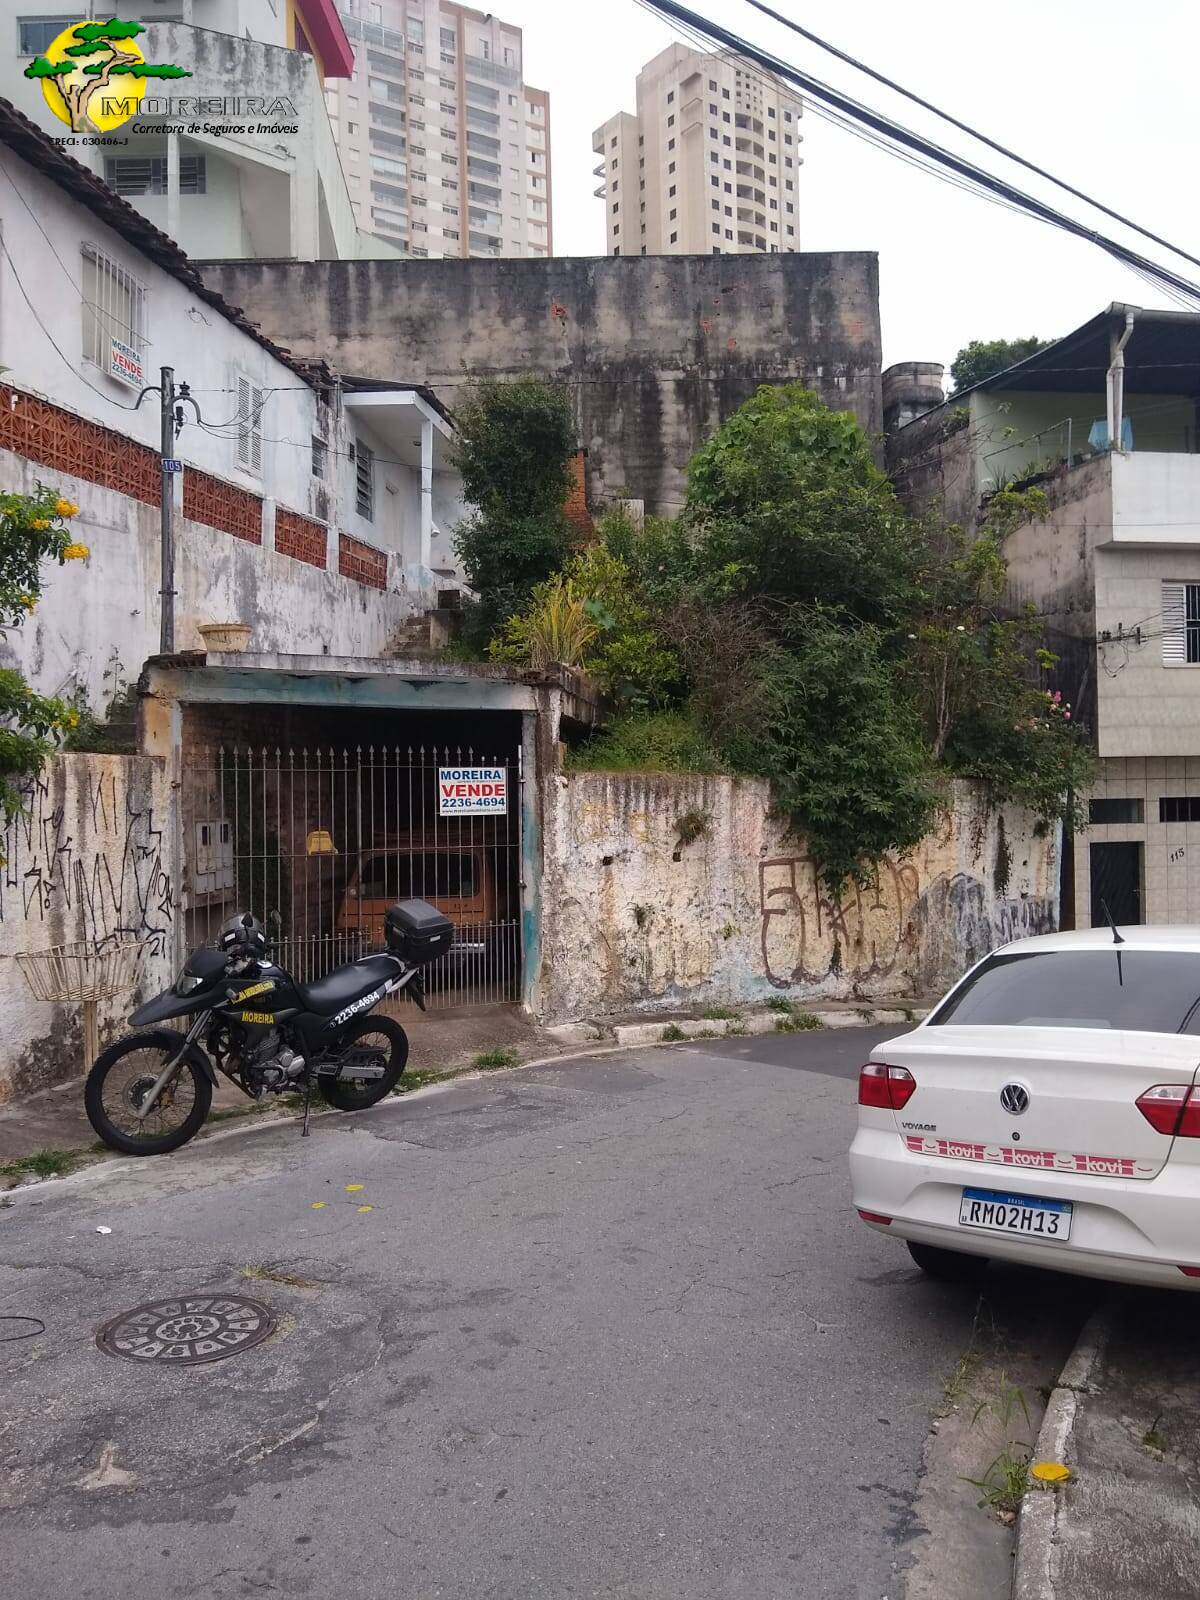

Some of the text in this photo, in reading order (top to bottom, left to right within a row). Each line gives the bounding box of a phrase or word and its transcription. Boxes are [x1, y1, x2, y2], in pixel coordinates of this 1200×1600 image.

[111, 338, 141, 363] MOREIRA
[112, 351, 142, 378] VENDE
[164, 460, 181, 471] 105
[441, 770, 501, 780] MOREIRA
[441, 784, 505, 797] VENDE
[442, 798, 505, 807] 2236-4694
[334, 991, 380, 1025] 2236-4694
[242, 1011, 275, 1025] MOREIRA
[901, 1122, 937, 1132] VOYAGE
